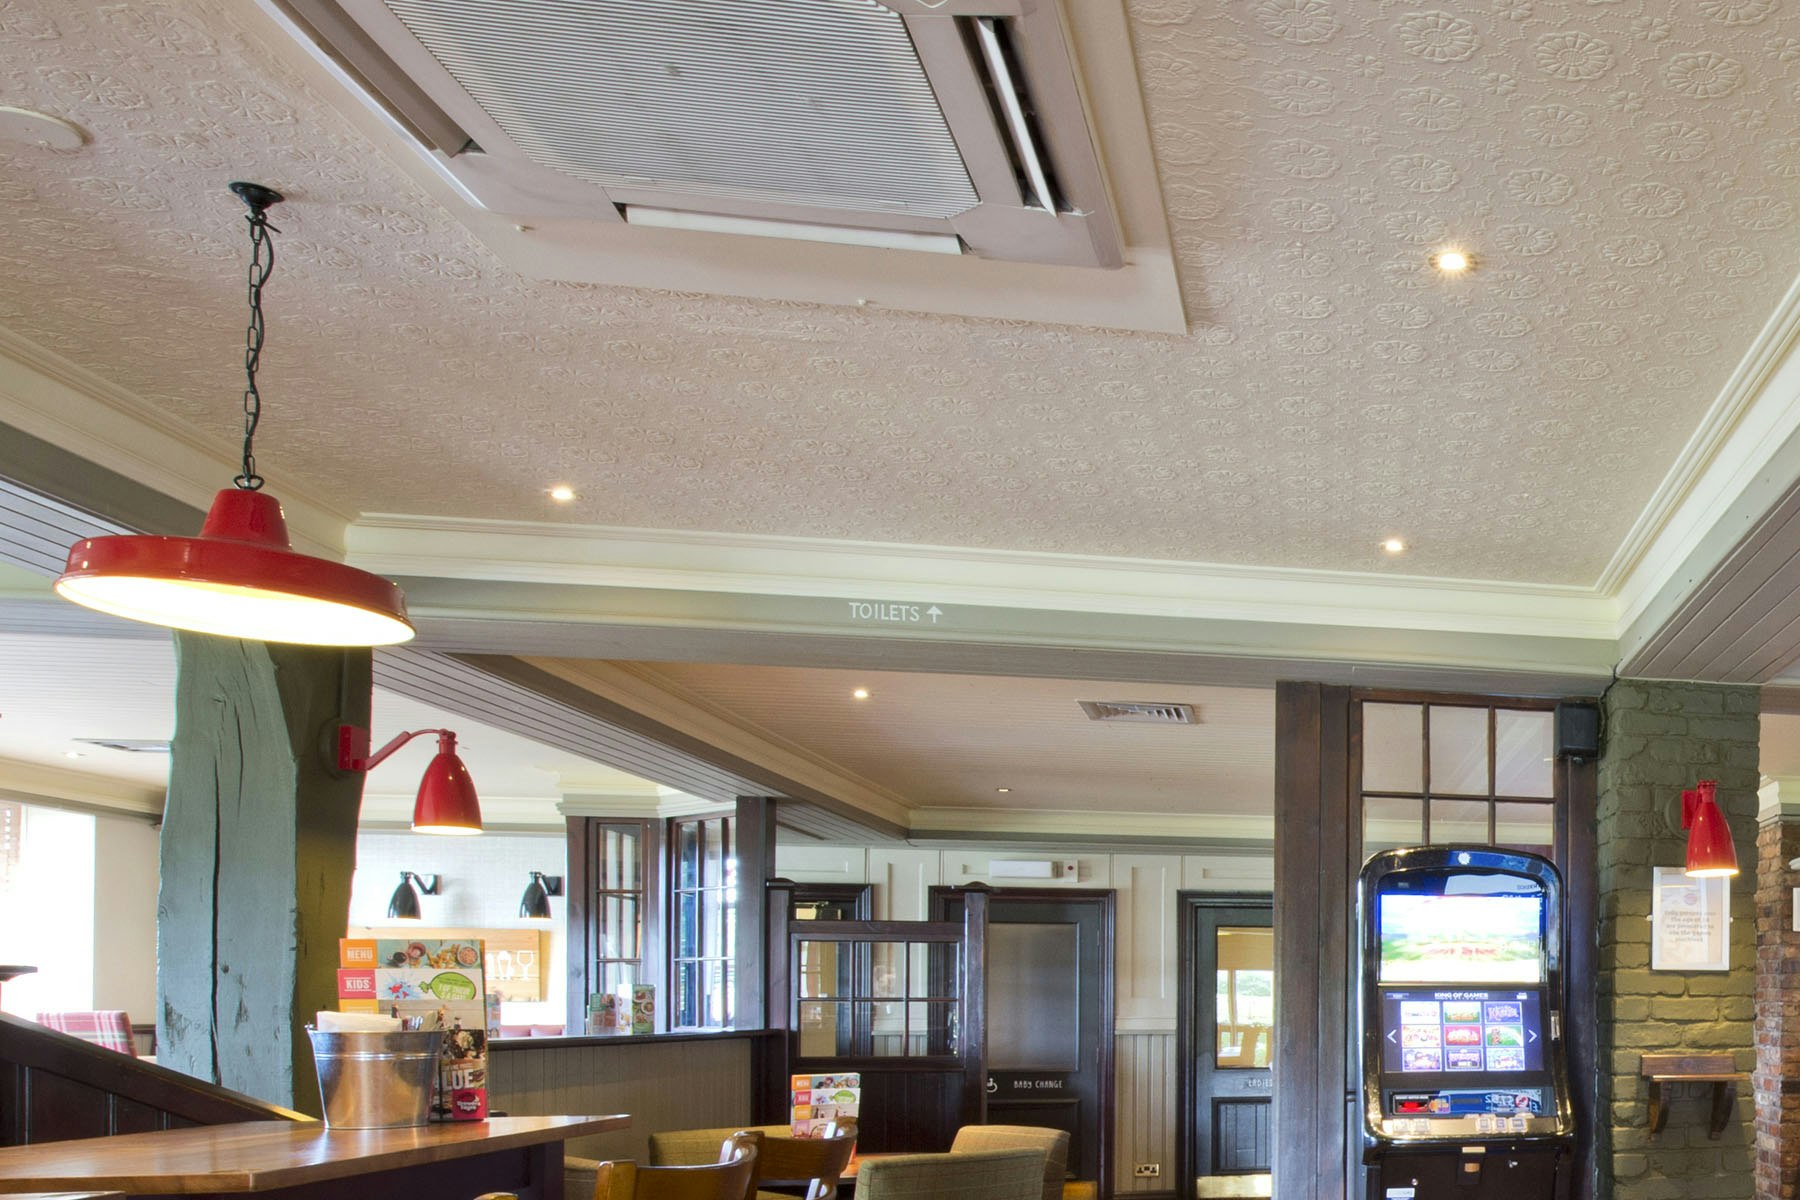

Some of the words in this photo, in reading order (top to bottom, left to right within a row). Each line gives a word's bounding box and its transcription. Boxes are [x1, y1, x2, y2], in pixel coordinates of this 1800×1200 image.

[848, 602, 920, 621] TOILETS
[347, 950, 372, 961] MENU
[346, 980, 370, 989] KIDS
[1014, 1080, 1032, 1088] BABY
[1035, 1080, 1063, 1088] CHANGE
